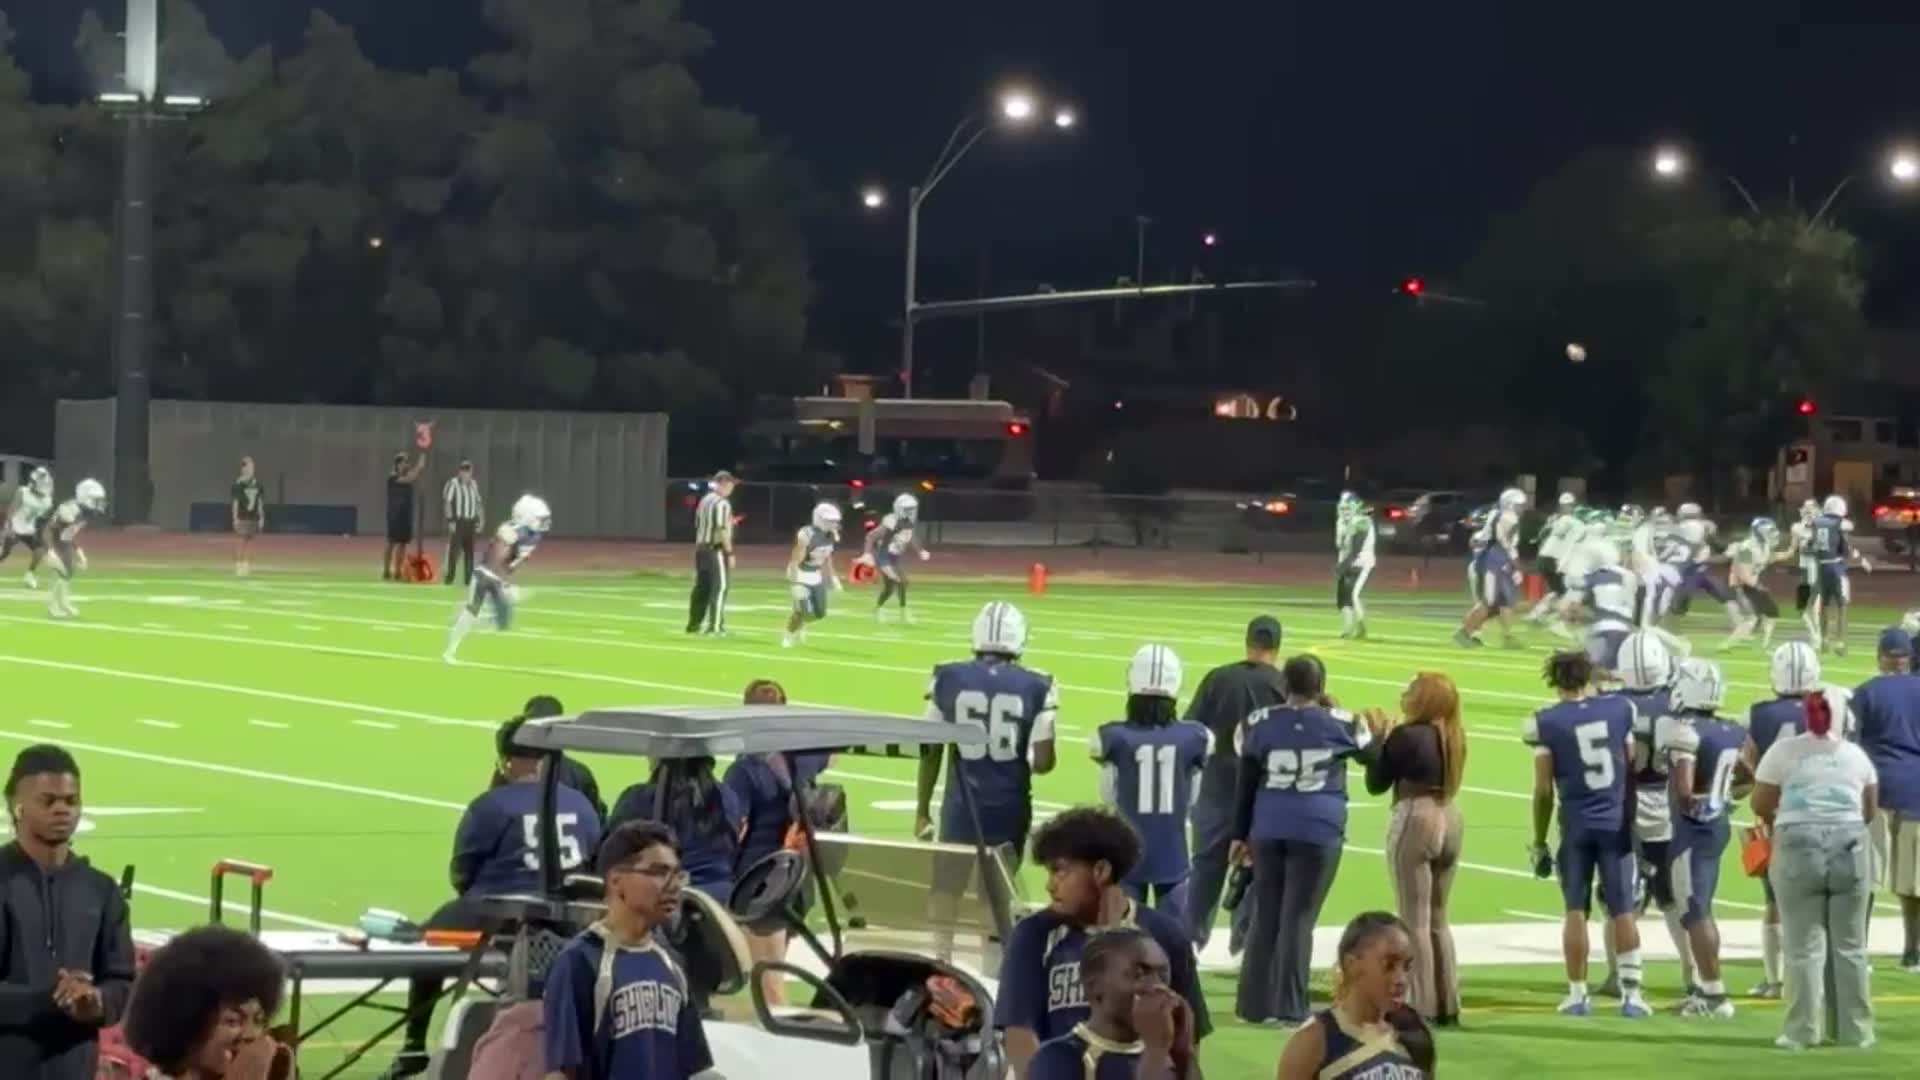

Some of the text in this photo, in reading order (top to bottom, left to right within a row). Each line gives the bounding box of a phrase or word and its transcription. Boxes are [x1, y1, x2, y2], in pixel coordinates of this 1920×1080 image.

[416, 423, 432, 448] 3
[955, 690, 1023, 761] 66
[1575, 720, 1616, 790] 5
[1135, 743, 1176, 814] 11
[522, 812, 582, 870] 55
